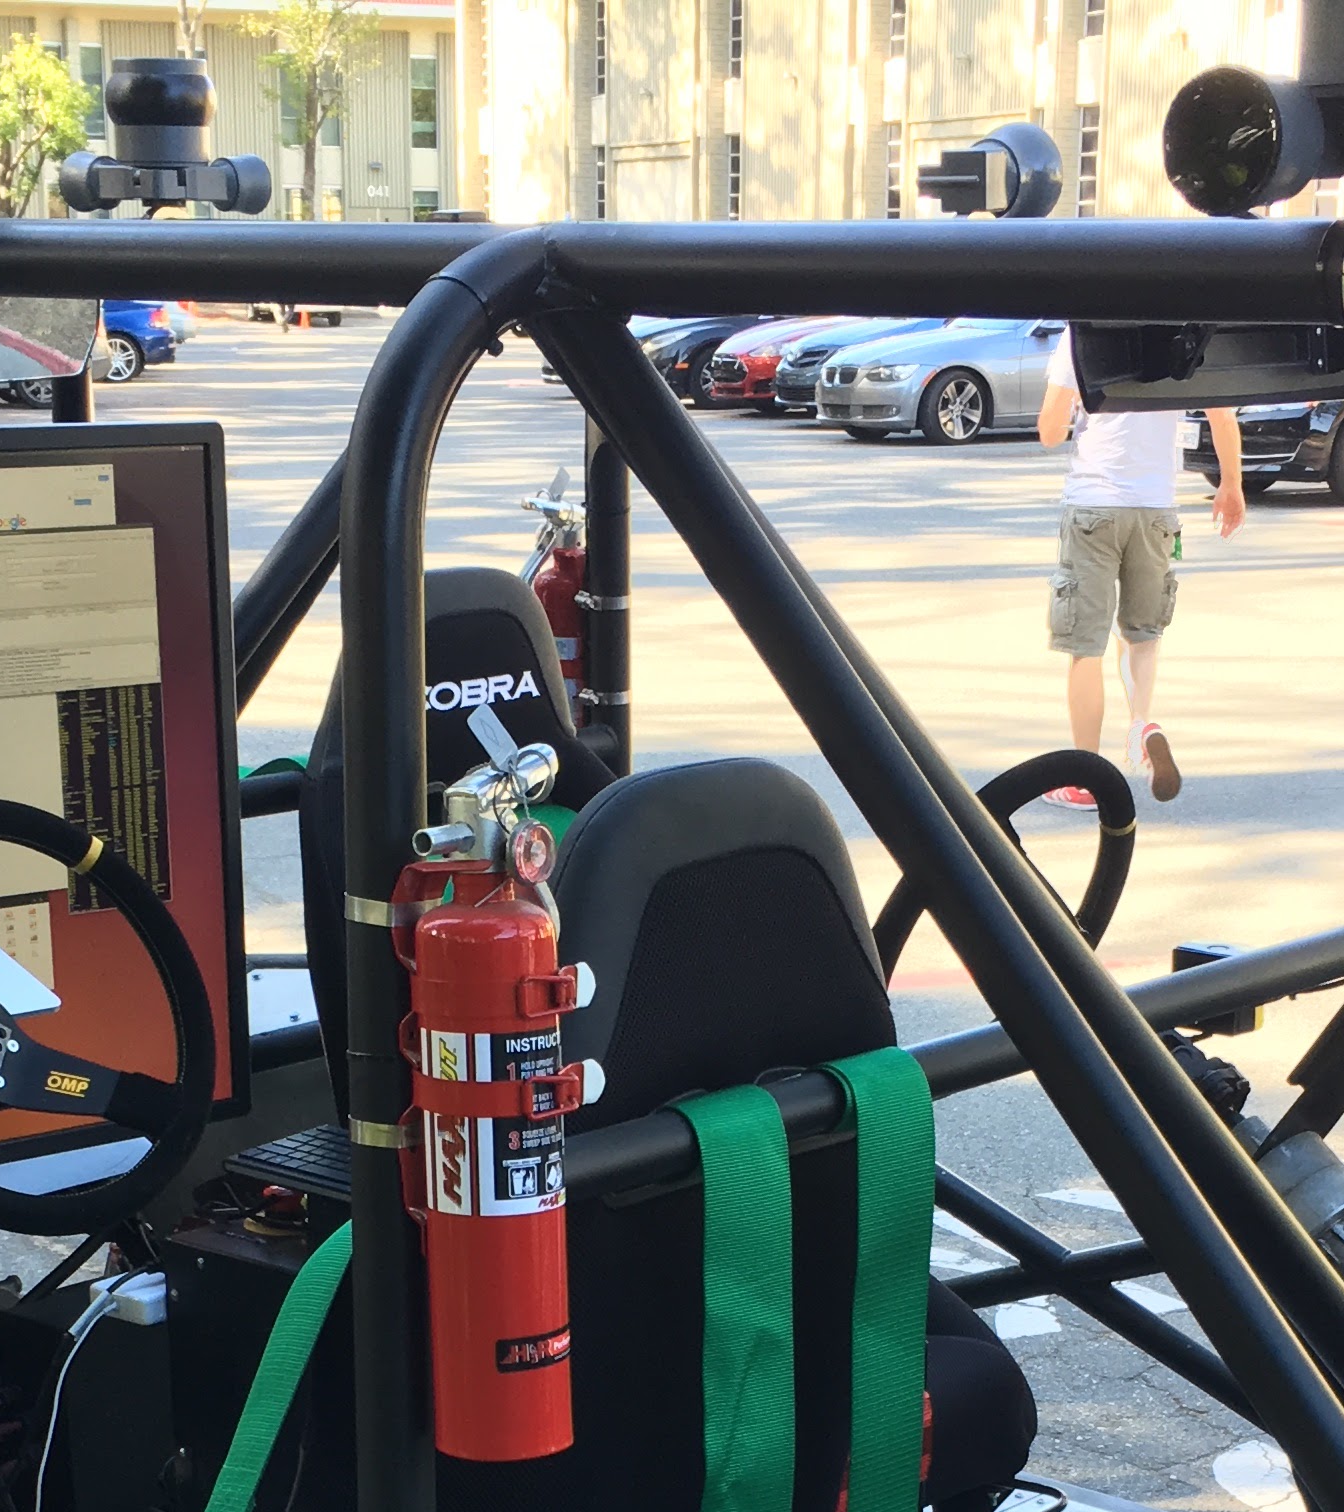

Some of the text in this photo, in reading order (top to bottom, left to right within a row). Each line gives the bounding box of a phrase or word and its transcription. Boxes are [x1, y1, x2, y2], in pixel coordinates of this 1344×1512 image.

[367, 185, 389, 197] 041
[425, 670, 541, 711] OBRA
[47, 1075, 89, 1093] OMP
[508, 1130, 520, 1150] 3
